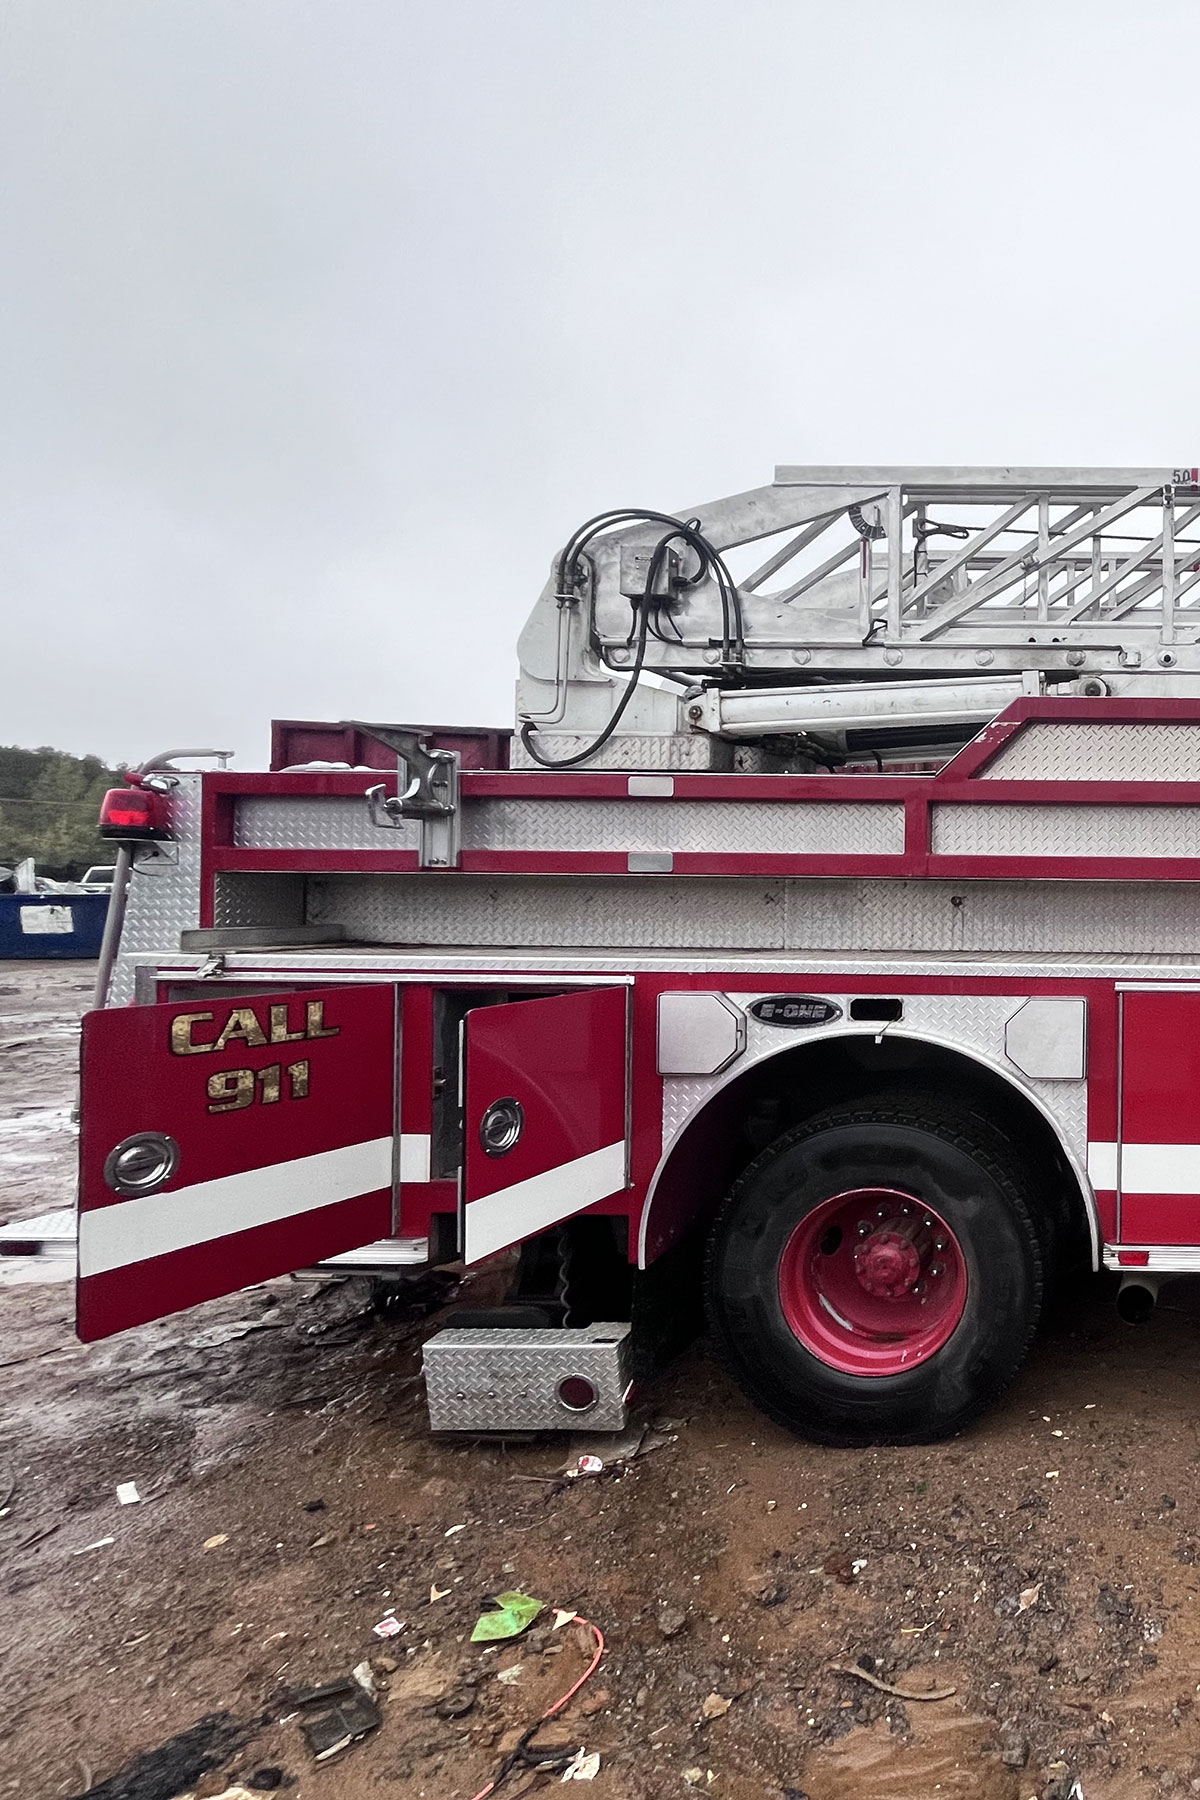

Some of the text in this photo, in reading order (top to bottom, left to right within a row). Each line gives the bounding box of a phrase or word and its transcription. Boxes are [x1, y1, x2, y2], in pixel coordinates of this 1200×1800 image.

[1172, 469, 1191, 484] 50
[170, 1000, 341, 1056] CALL
[759, 1003, 828, 1019] E-ONE
[206, 1059, 310, 1114] 911
